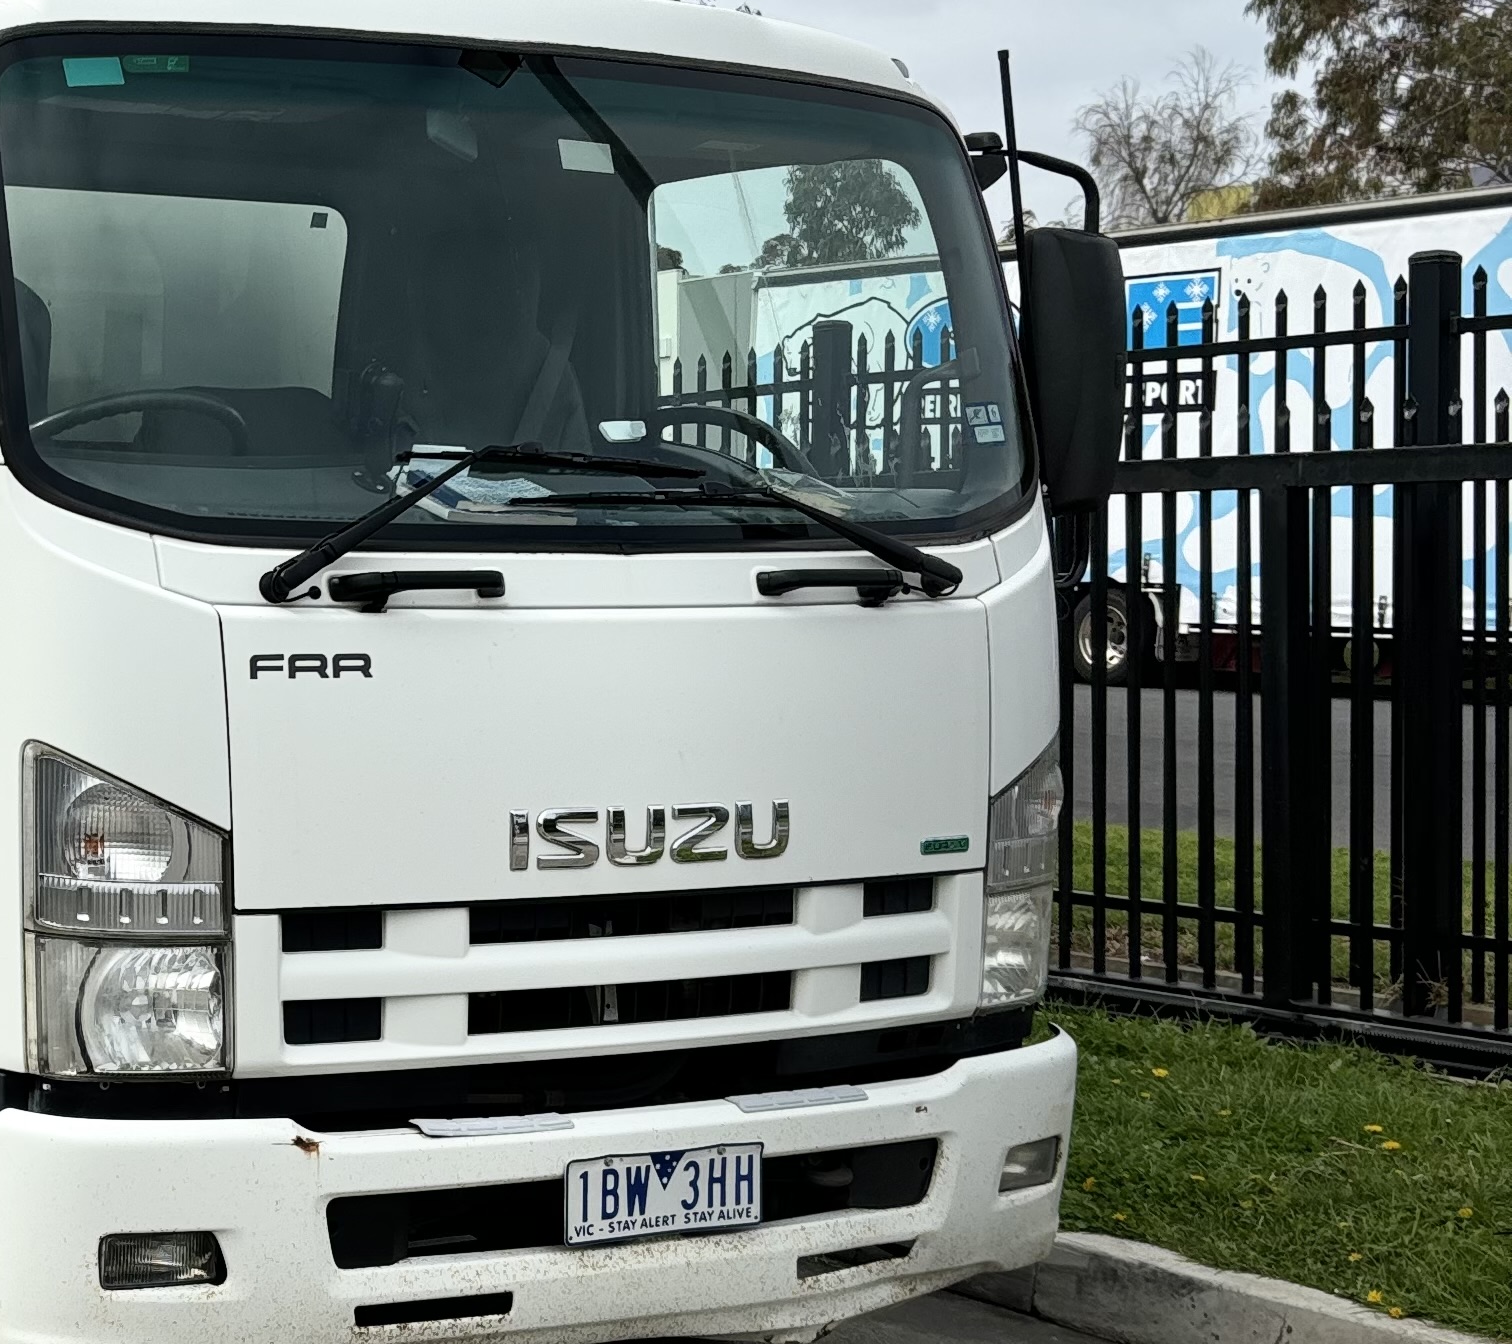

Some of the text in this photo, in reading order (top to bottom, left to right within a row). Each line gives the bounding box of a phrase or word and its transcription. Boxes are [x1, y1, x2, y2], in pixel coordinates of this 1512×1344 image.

[249, 653, 373, 680] FRR
[509, 798, 790, 872] ISUZU
[579, 1154, 754, 1223] 1BW 3HH
[574, 1223, 595, 1238] VIC
[607, 1218, 638, 1234] STAY
[639, 1213, 677, 1230] ALERT
[683, 1209, 715, 1225] STAY
[717, 1206, 753, 1222] ALIVE
